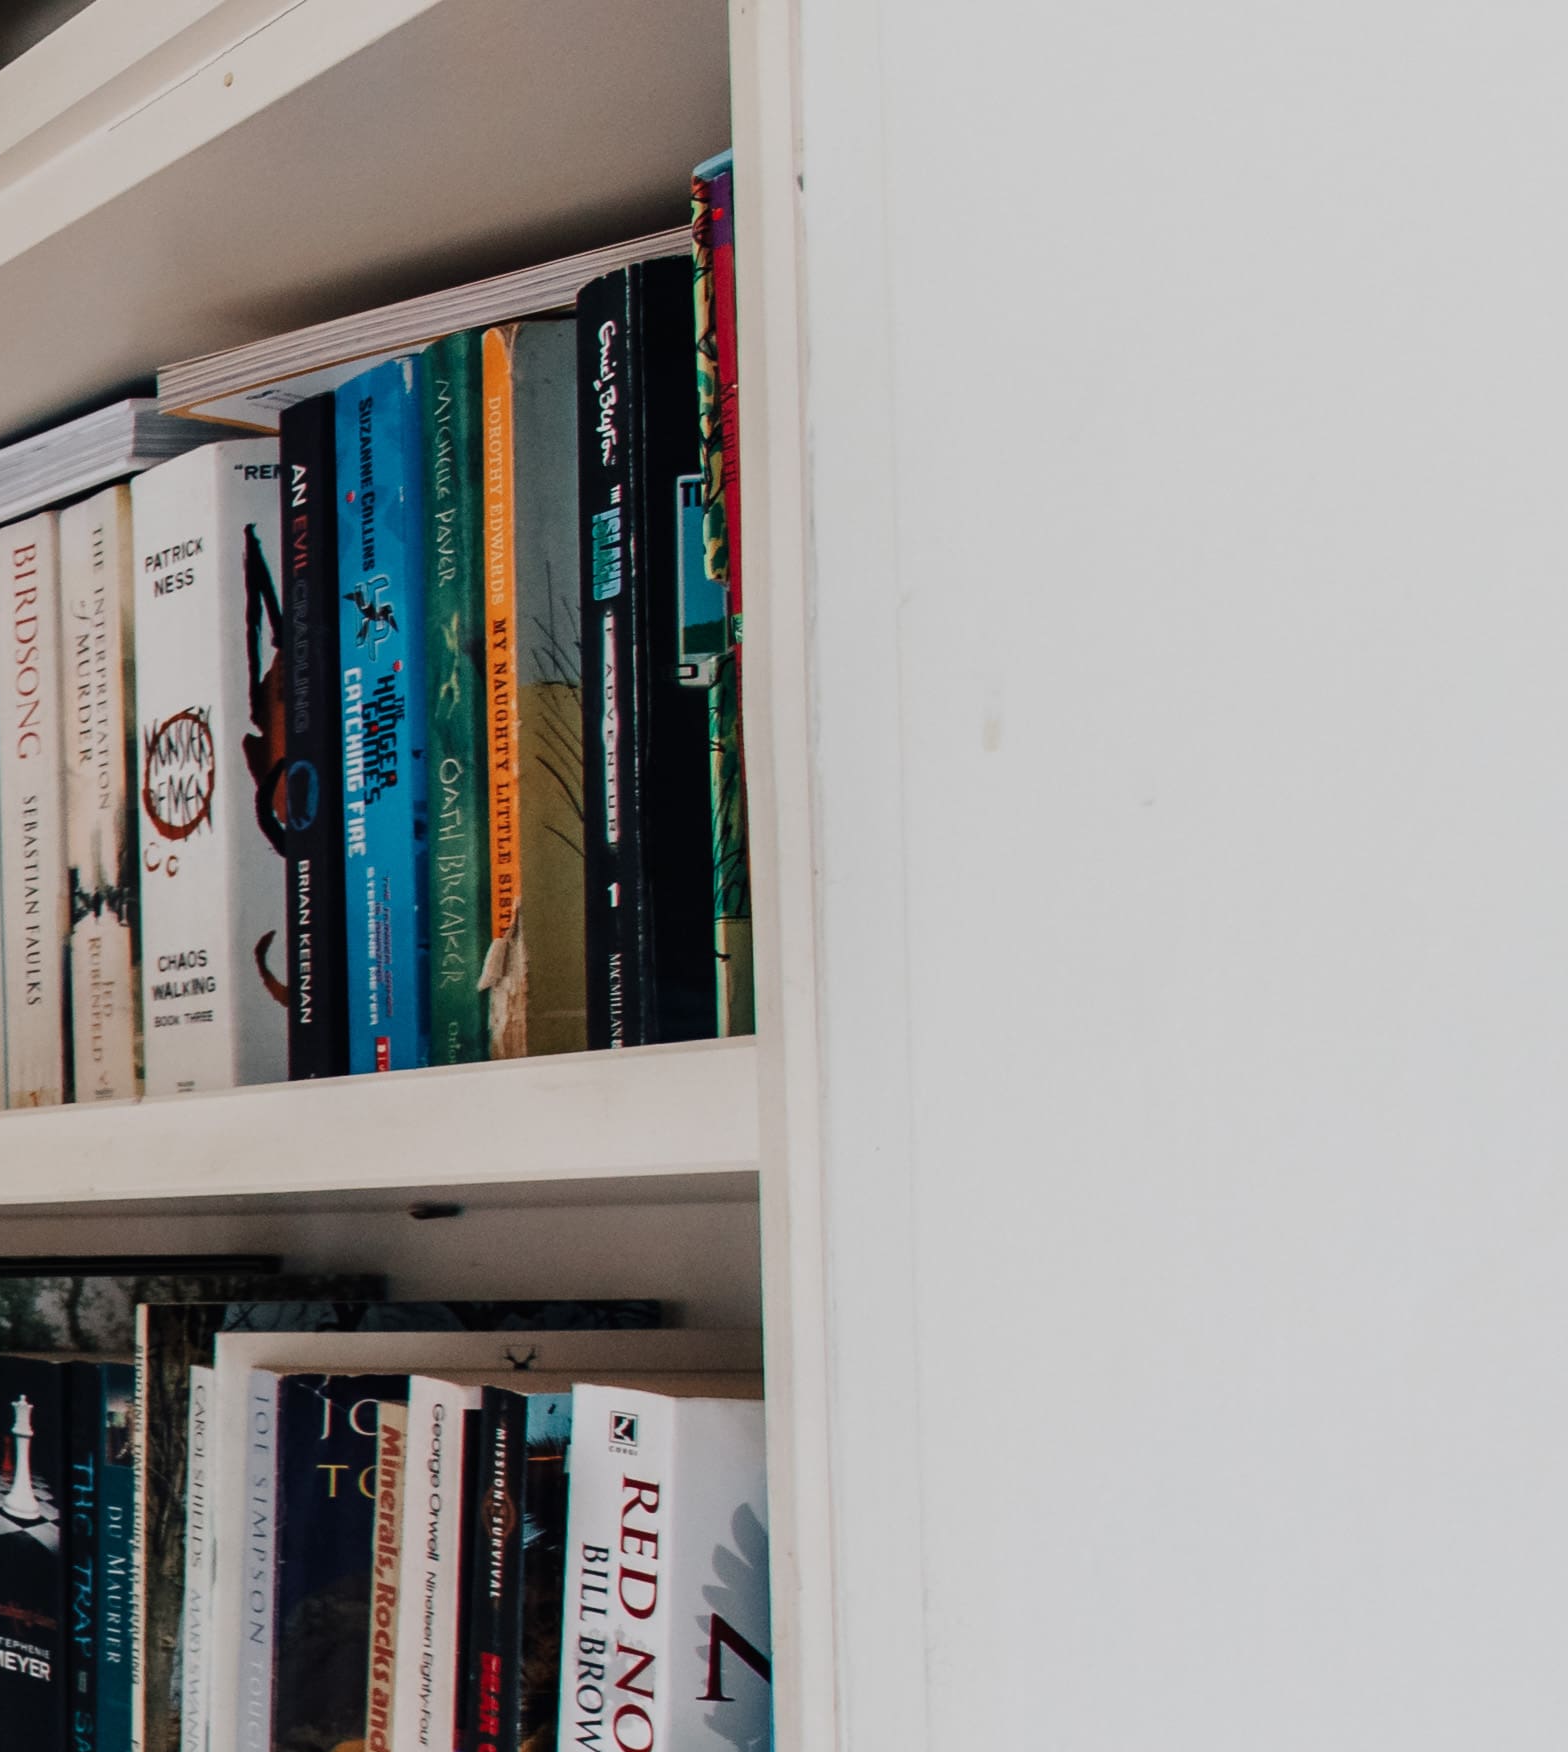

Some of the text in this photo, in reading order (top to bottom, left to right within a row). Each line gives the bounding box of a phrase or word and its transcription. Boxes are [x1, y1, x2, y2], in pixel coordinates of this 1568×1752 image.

[358, 397, 375, 572] SUZANNE COLLINS
[434, 379, 454, 588] MICHELLE PAVER
[145, 537, 204, 574] PATRICK
[153, 568, 195, 598] NESS
[291, 464, 311, 733] AN EVIL CRADLING
[592, 508, 622, 601] ISLAND
[92, 526, 112, 810] THE INTERPRETATION
[487, 395, 512, 866] DOROTHY EDWARDS MY NAUGHTY LITTLE
[76, 634, 94, 768] MURDER
[344, 666, 366, 858] CATCHING FIRE
[13, 543, 43, 1007] BIRDSONG SEBASTIAN FAULKS
[157, 950, 208, 973] CHAOS
[298, 859, 312, 1024] BRIAN KEENAN
[438, 855, 466, 990] BREAKER
[607, 882, 621, 907] 1
[152, 976, 217, 1001] WALKING
[154, 1009, 214, 1028] BOOK THREE
[192, 1384, 207, 1568] CAROL SHIELDS
[254, 1396, 270, 1451] JOE
[427, 1402, 445, 1562] George Orwell
[607, 1445, 639, 1456] CORGI
[72, 1452, 94, 1657] THE TRAP
[249, 1476, 269, 1646] SIMPSON
[375, 1423, 403, 1579] Minerals,
[490, 1517, 504, 1600] SURVIVAL
[618, 1471, 661, 1621] RED
[106, 1505, 125, 1663] DU MAURIER
[374, 1582, 397, 1684] Rocks
[578, 1542, 610, 1623] BILL
[367, 1687, 392, 1752] and
[478, 1651, 502, 1736] BEAR
